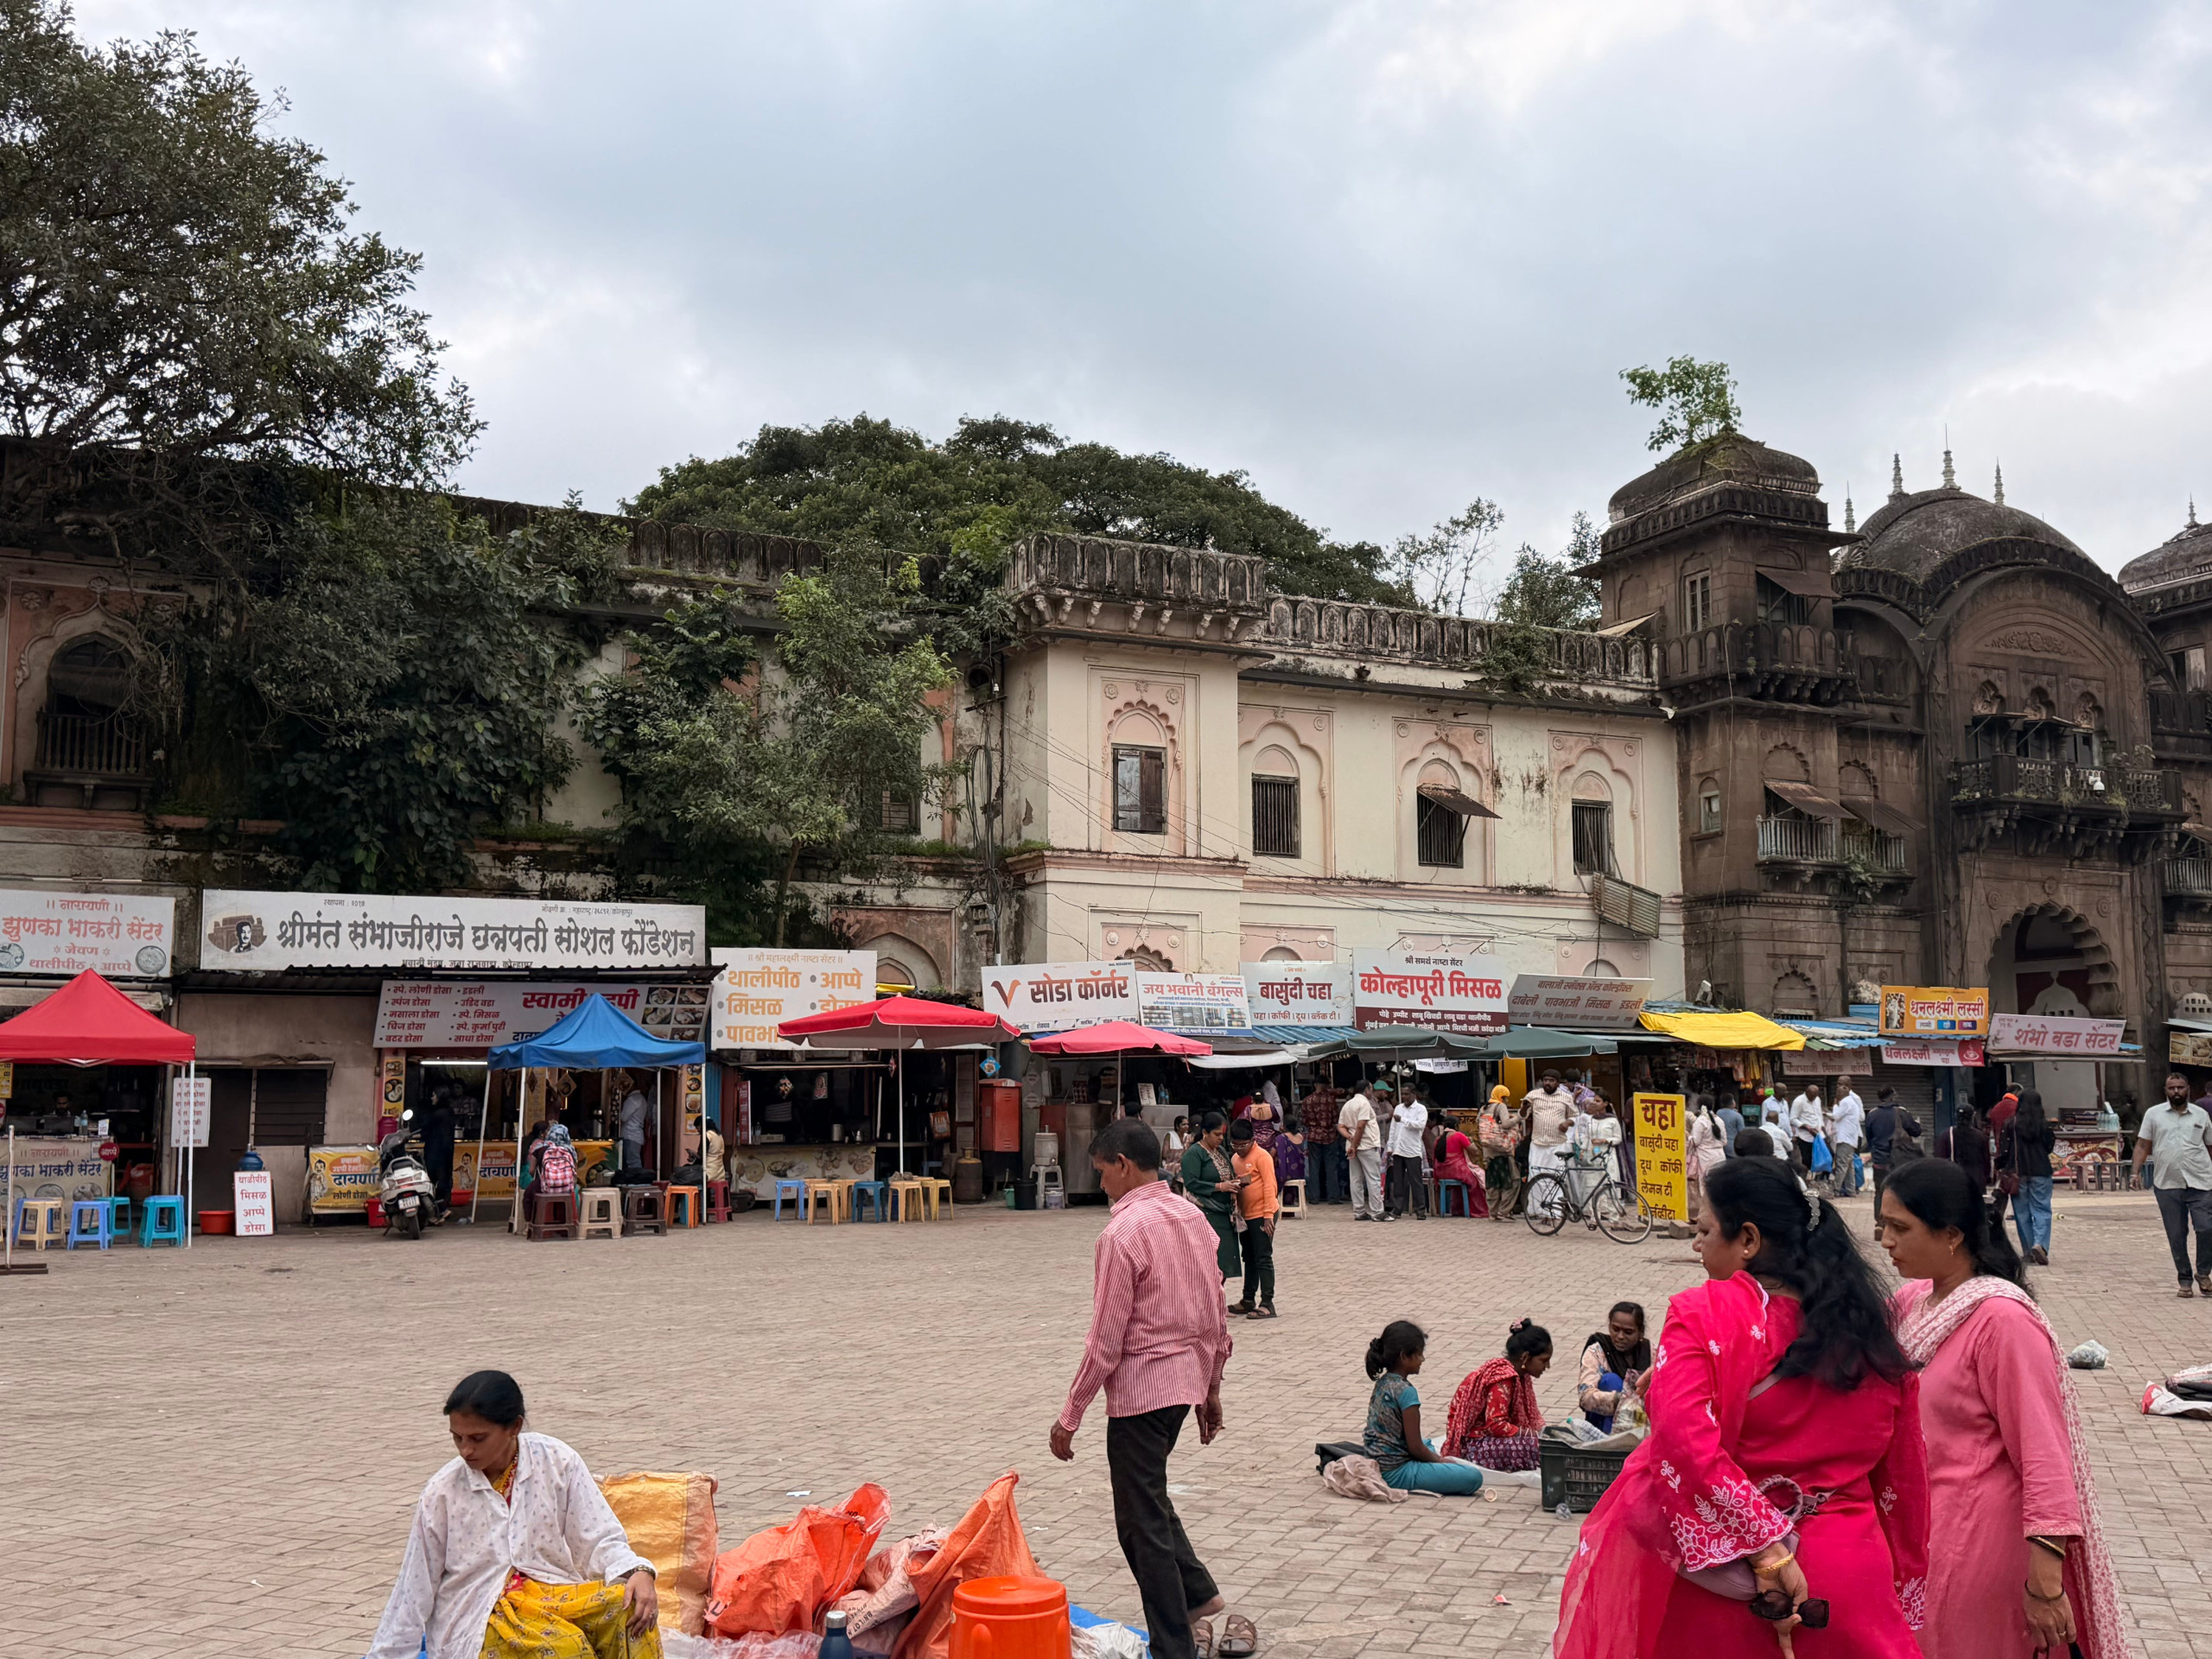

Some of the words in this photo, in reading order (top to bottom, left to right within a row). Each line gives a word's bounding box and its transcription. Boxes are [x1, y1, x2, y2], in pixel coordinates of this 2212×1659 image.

[59, 899, 110, 912] नारायणी
[323, 899, 345, 907] स्थापना
[3, 917, 62, 942] झुणका
[68, 916, 122, 940] भाकरी
[127, 916, 163, 941] सेंटर
[276, 910, 342, 949] श्रीमंत
[348, 911, 465, 952] संभाजीराजे
[472, 917, 548, 952] छत्रपती
[555, 918, 616, 956] सोशल
[620, 918, 696, 958] फौंडेशन
[65, 942, 99, 956] जेवण
[29, 957, 86, 969] थालीपीठ
[100, 961, 132, 972] आप्पे
[754, 952, 764, 962] श्री
[766, 952, 799, 963] महालक्ष्मी
[801, 954, 818, 963] नाष्टा
[821, 953, 836, 963] सेंटर
[1415, 956, 1431, 964] समर्थ
[1432, 957, 1448, 966] नाष्टा
[1449, 957, 1463, 967] सेंटर
[728, 966, 802, 988] थालीपीठ
[820, 968, 863, 989] आप्पे
[1538, 979, 1565, 989] बालाजी
[409, 984, 432, 995] लोणी
[434, 985, 452, 995] डोसा
[1028, 973, 1072, 1003] सोडा
[1076, 969, 1128, 1000] कॉर्नर
[1141, 984, 1165, 995] जय
[1166, 982, 1204, 996] भवानी
[1258, 977, 1304, 1006] बासुंदी
[1306, 982, 1332, 1000] चहा
[1359, 966, 1445, 1006] कोल्हापूरी
[1448, 970, 1502, 999] मिसळ
[411, 996, 431, 1007] डोसा
[522, 988, 587, 1009] स्वामी
[726, 993, 784, 1015] मिसळ
[1512, 994, 1539, 1006] दाबेली
[1545, 995, 1581, 1008] पावभाजी
[1585, 996, 1612, 1009] मिसळ
[1619, 998, 1643, 1010] इडली
[1910, 996, 1954, 1016] धनलक्ष्मी
[1957, 996, 1984, 1016] लस्सी
[389, 1010, 419, 1019] मसाला
[421, 1009, 440, 1019] डोसा
[474, 1008, 500, 1019] मिसळ
[1254, 1012, 1266, 1020] चहा
[1271, 1011, 1290, 1020] कॉफी
[407, 1021, 426, 1030] डोसा
[492, 1021, 506, 1033] पुरी
[404, 1033, 423, 1042] डोसा
[476, 1033, 494, 1042] डोसा
[2014, 1023, 2049, 1046] शंभो
[2052, 1030, 2082, 1048] वडा
[2085, 1027, 2118, 1050] सेंटर
[1885, 1045, 1930, 1060] धनलक्ष्मी
[1640, 1098, 1676, 1130] चहा
[1639, 1134, 1662, 1153] बासुंदी
[1664, 1138, 1679, 1152] चहा
[39, 1160, 73, 1178] भाकरी
[78, 1159, 101, 1178] सेंटर
[1640, 1159, 1651, 1176] दूध
[1660, 1158, 1682, 1175] कॉफी
[240, 1189, 267, 1200] मिसळ
[1641, 1179, 1662, 1195] लेमन
[1663, 1181, 1673, 1197] टी
[243, 1205, 265, 1217] आप्पे
[244, 1221, 265, 1232] डोसा
